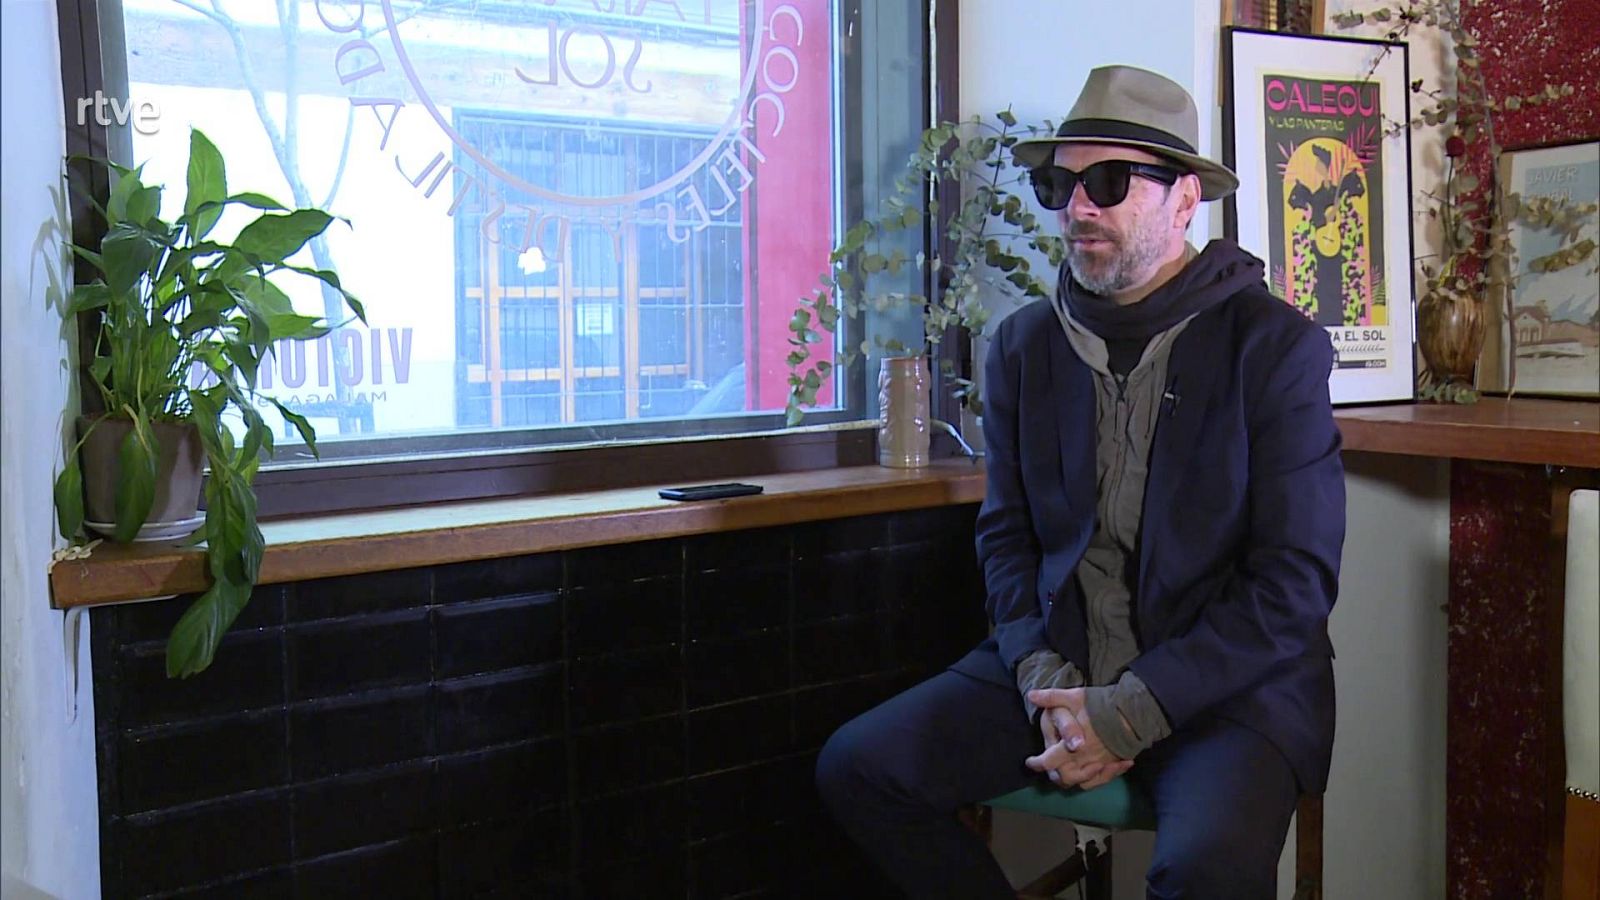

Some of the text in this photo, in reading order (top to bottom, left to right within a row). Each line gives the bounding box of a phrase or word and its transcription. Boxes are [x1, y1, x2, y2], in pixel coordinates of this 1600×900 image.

[1267, 80, 1378, 117] CALEQUI
[1344, 331, 1358, 341] EL
[1362, 330, 1385, 341] SOL
